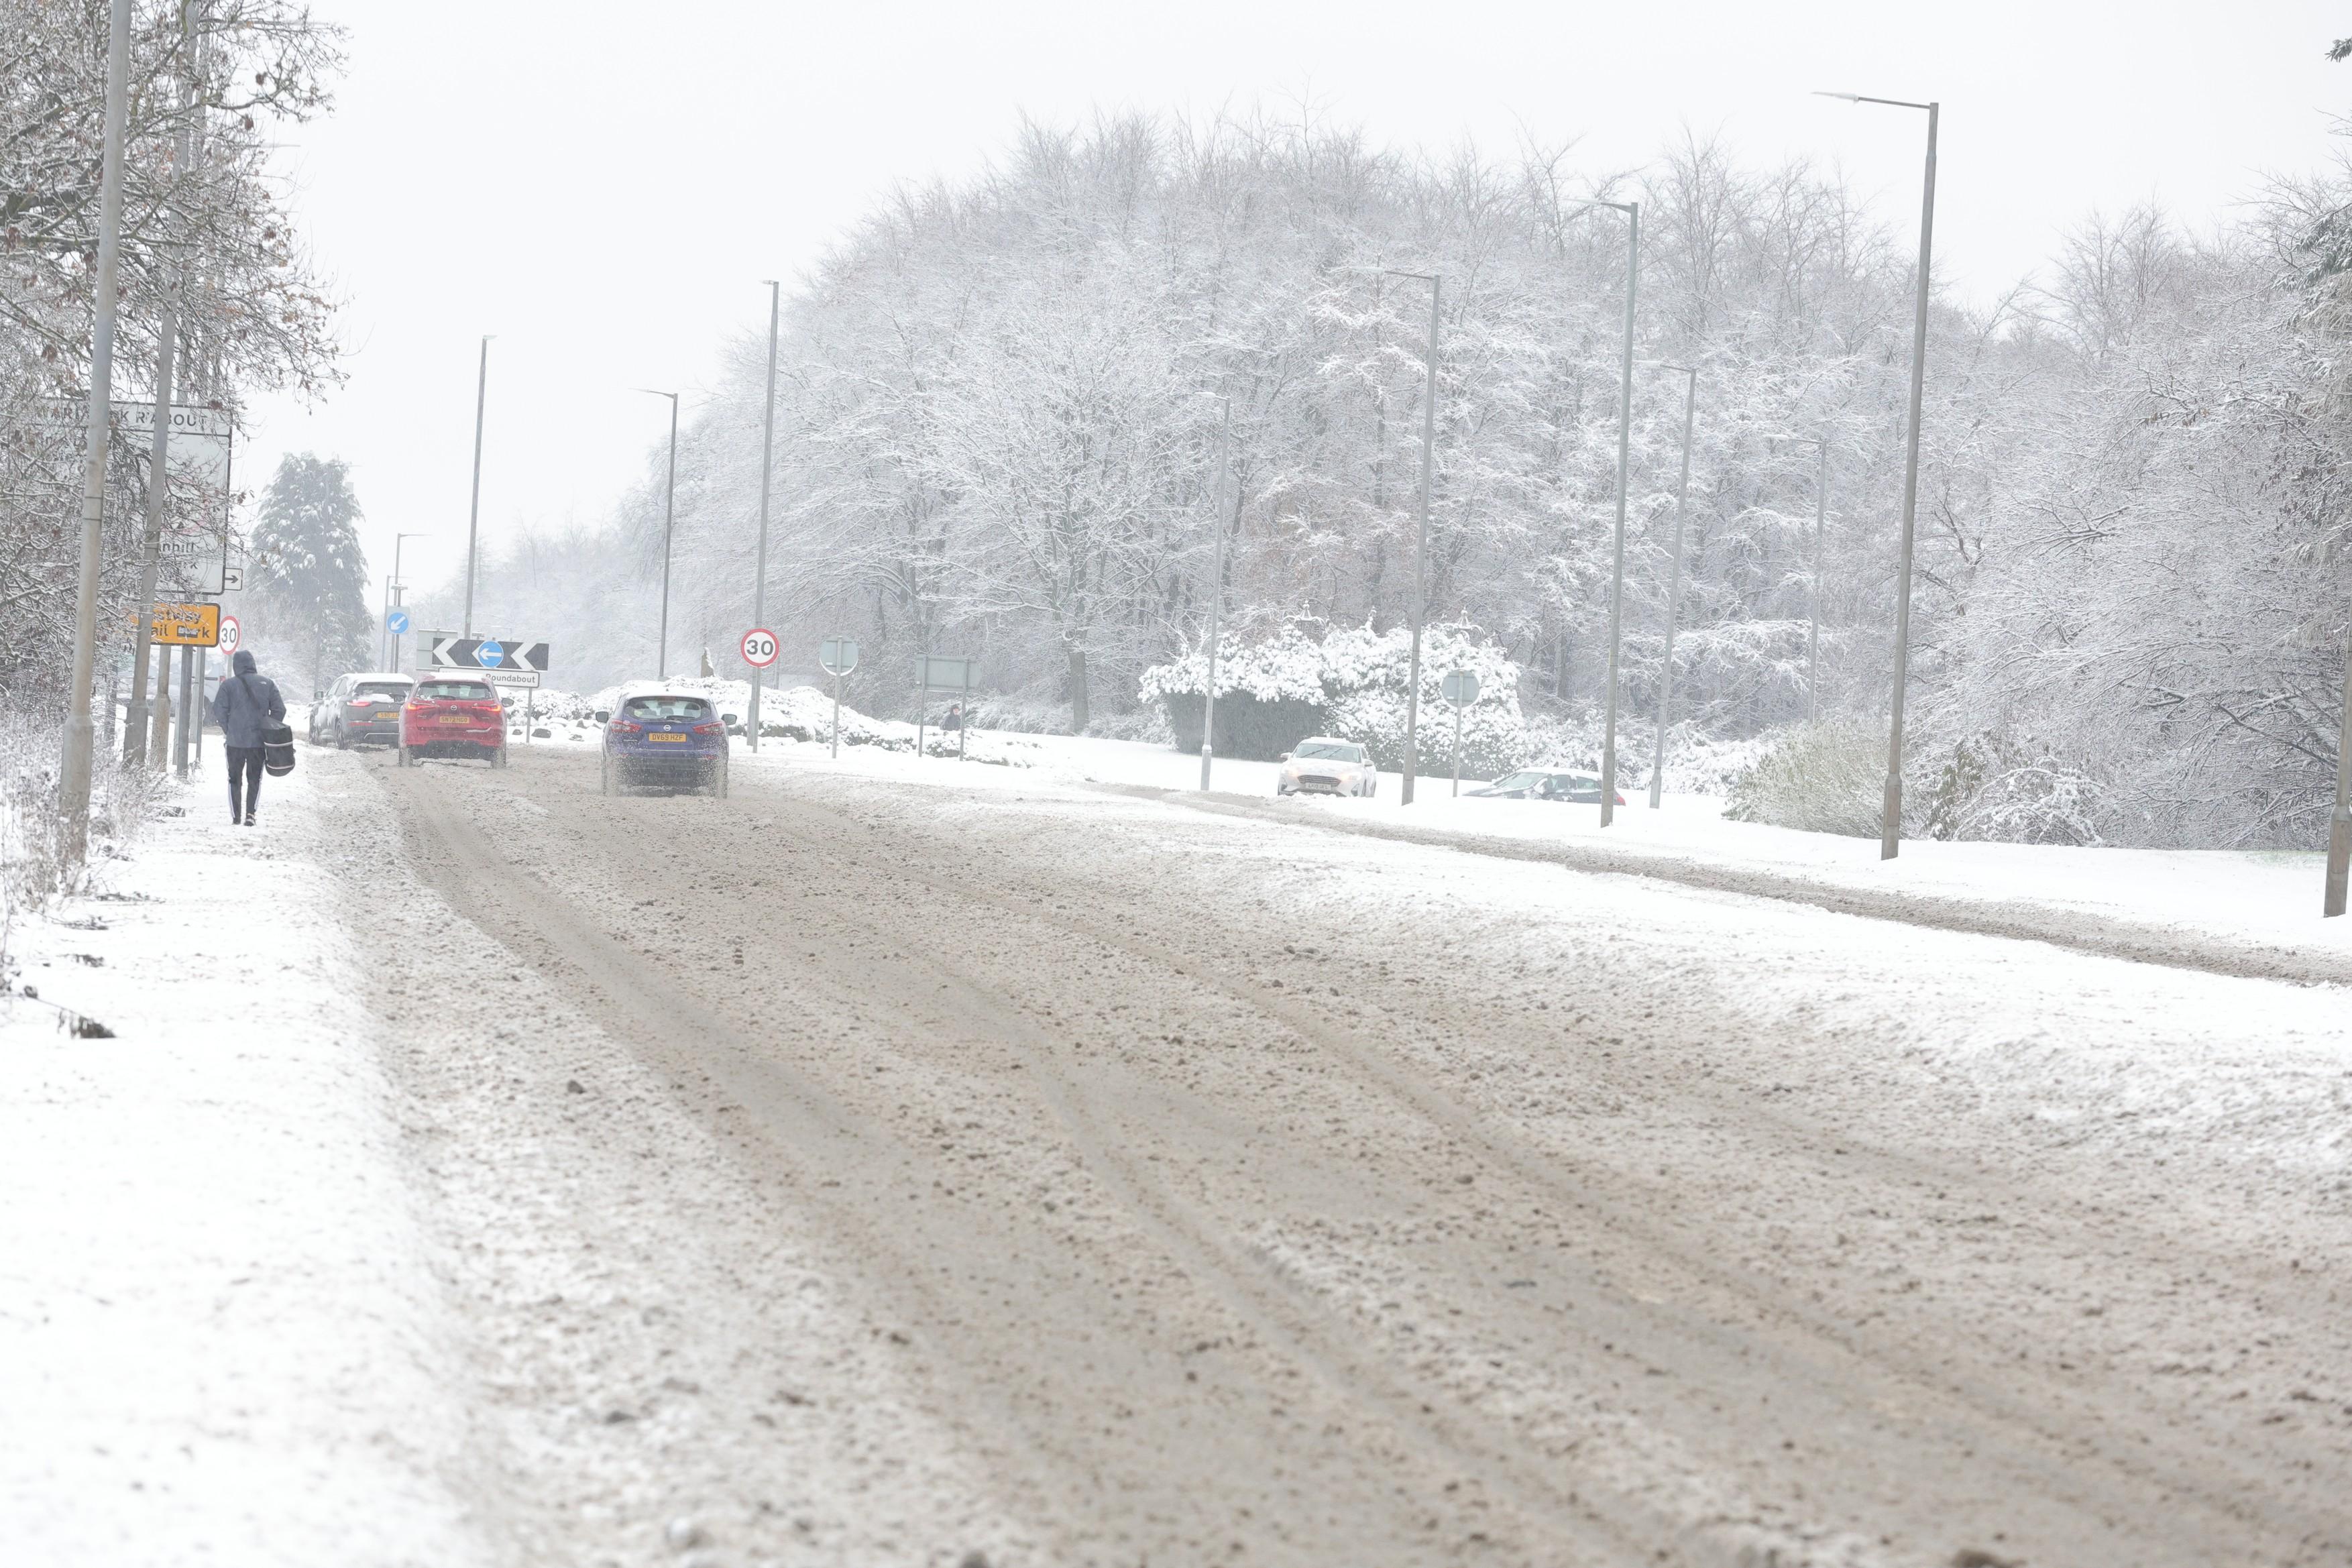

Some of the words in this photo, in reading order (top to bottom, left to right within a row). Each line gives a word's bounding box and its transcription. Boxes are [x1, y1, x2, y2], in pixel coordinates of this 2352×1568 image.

[221, 628, 237, 643] 30
[746, 639, 774, 656] 30
[486, 673, 535, 683] Roundabout
